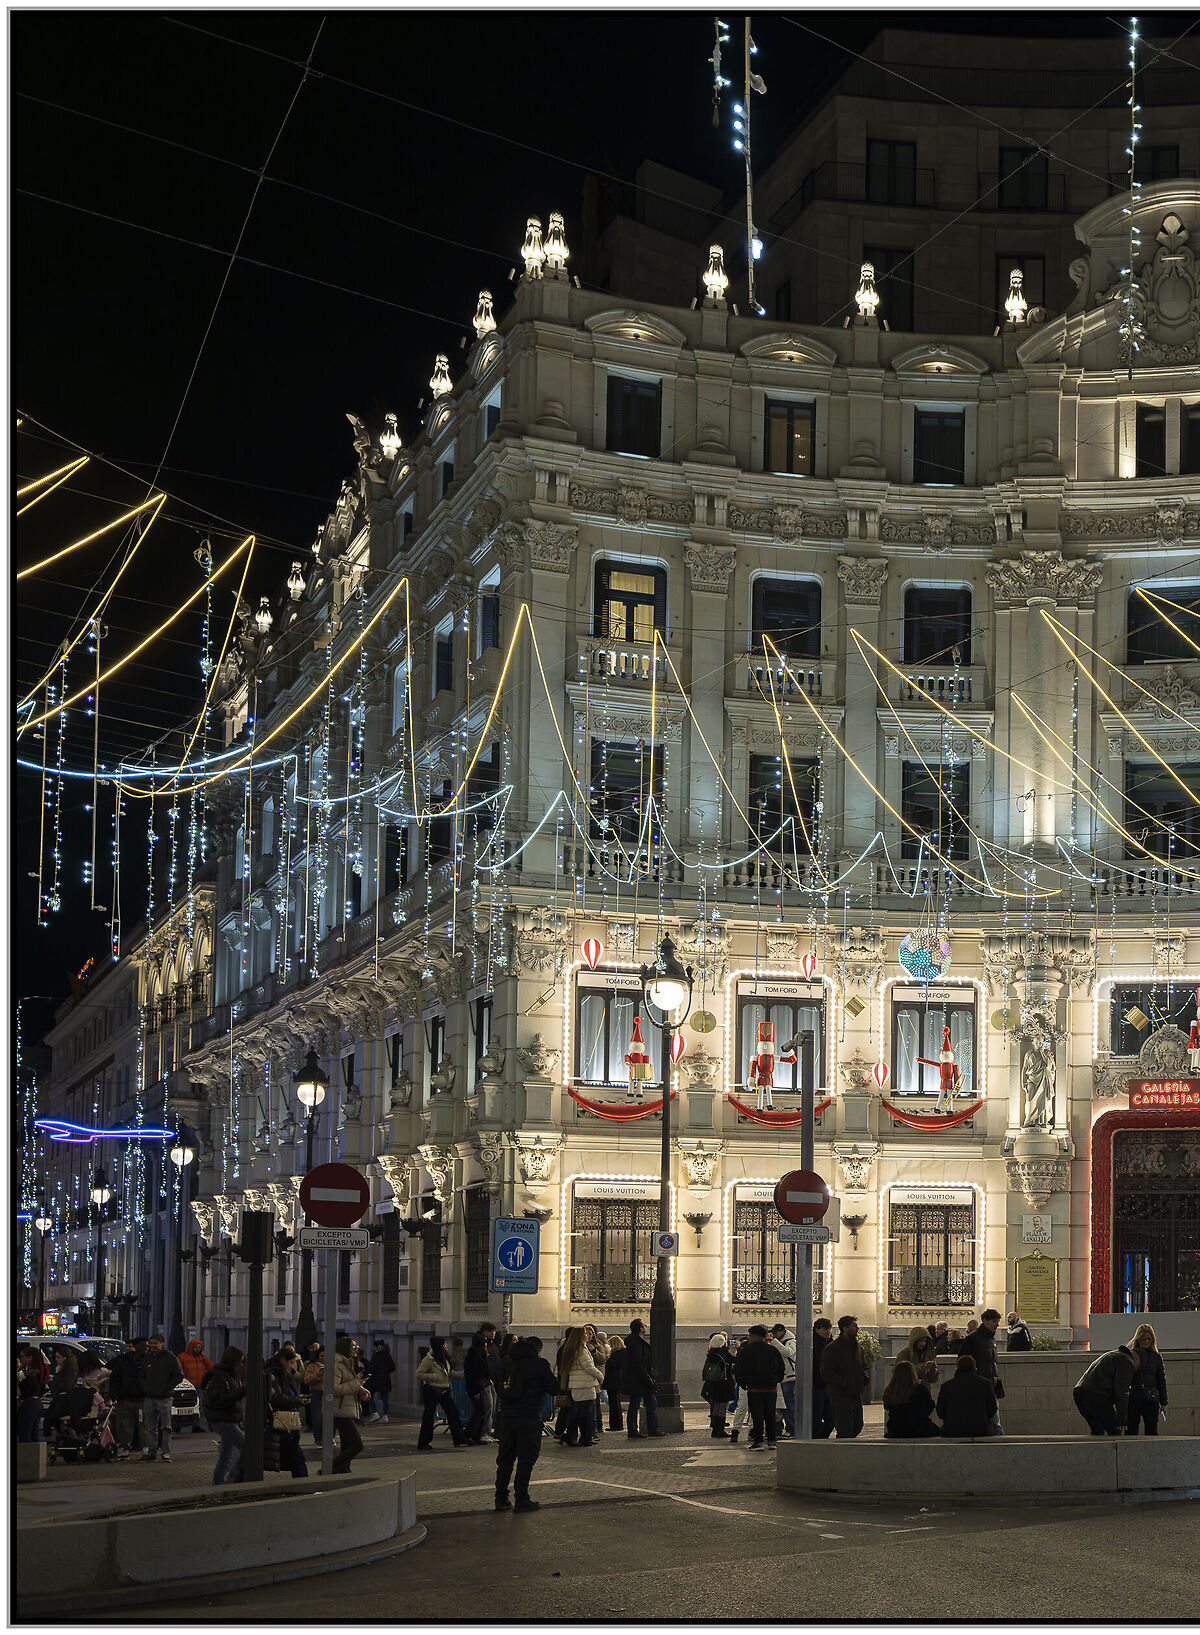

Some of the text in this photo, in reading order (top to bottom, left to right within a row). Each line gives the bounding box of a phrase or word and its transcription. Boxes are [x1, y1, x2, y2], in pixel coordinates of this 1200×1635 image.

[1142, 1081, 1190, 1093] GALERÍA
[1133, 1093, 1200, 1105] CANALEJAS
[511, 1222, 535, 1230] ZONA
